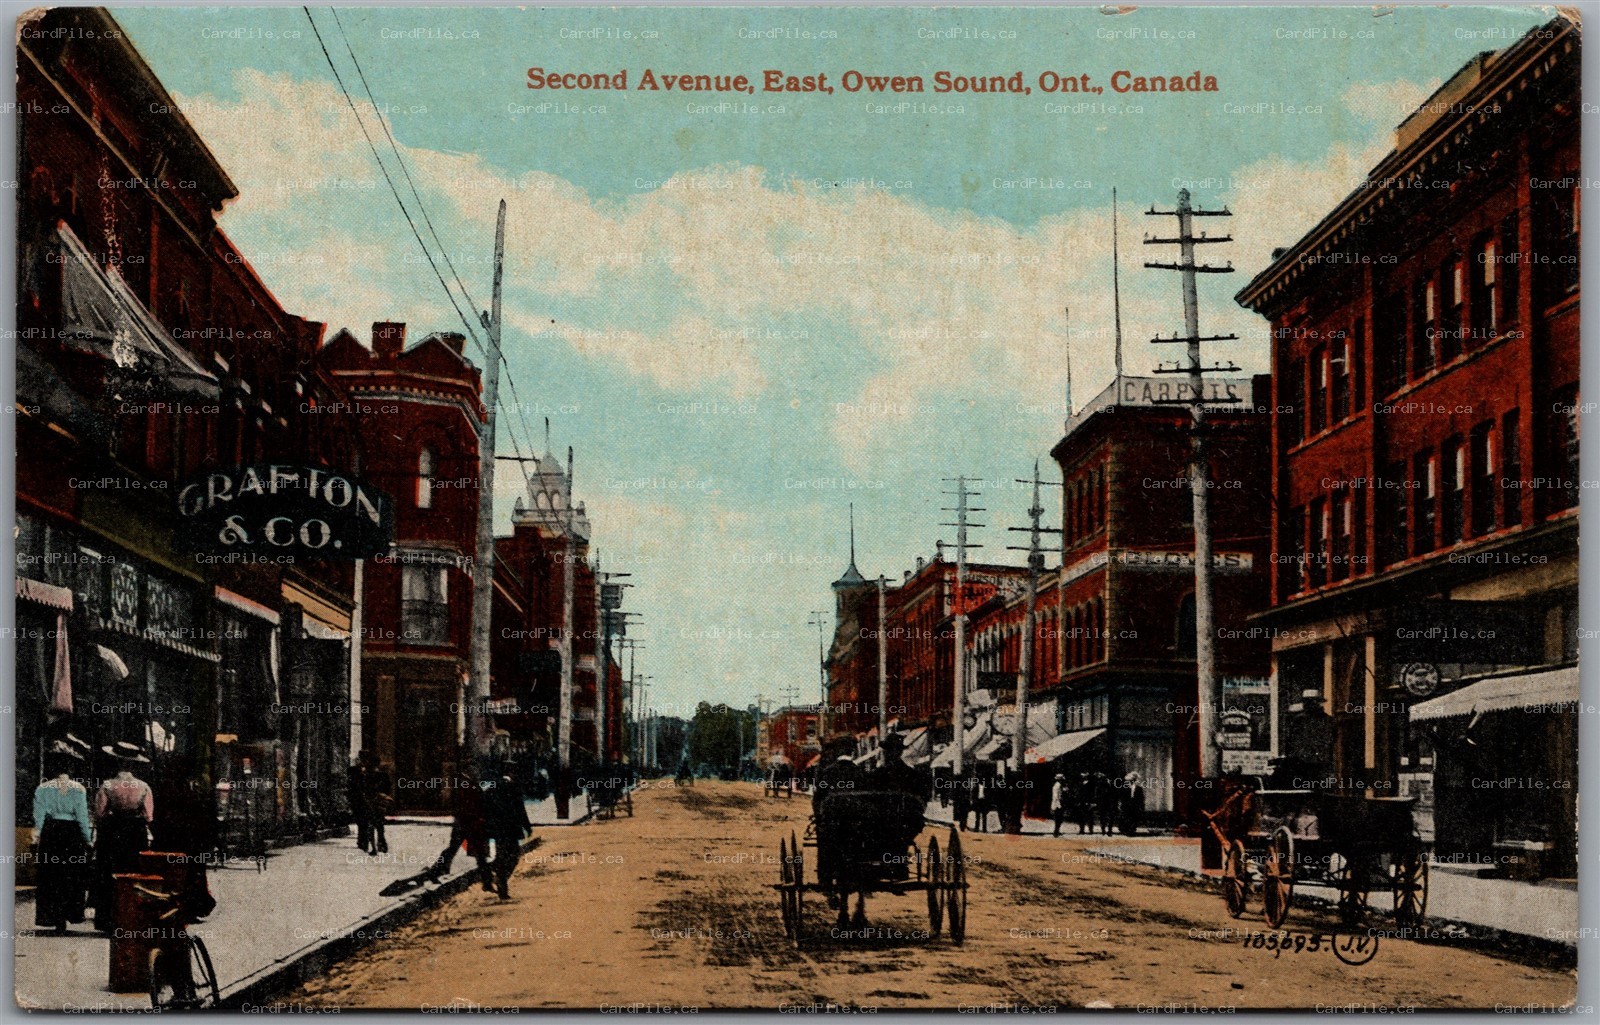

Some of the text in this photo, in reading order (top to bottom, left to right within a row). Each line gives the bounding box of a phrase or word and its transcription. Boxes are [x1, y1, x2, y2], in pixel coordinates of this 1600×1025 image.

[178, 465, 383, 527] GRAFTON
[218, 514, 342, 548] & CO.
